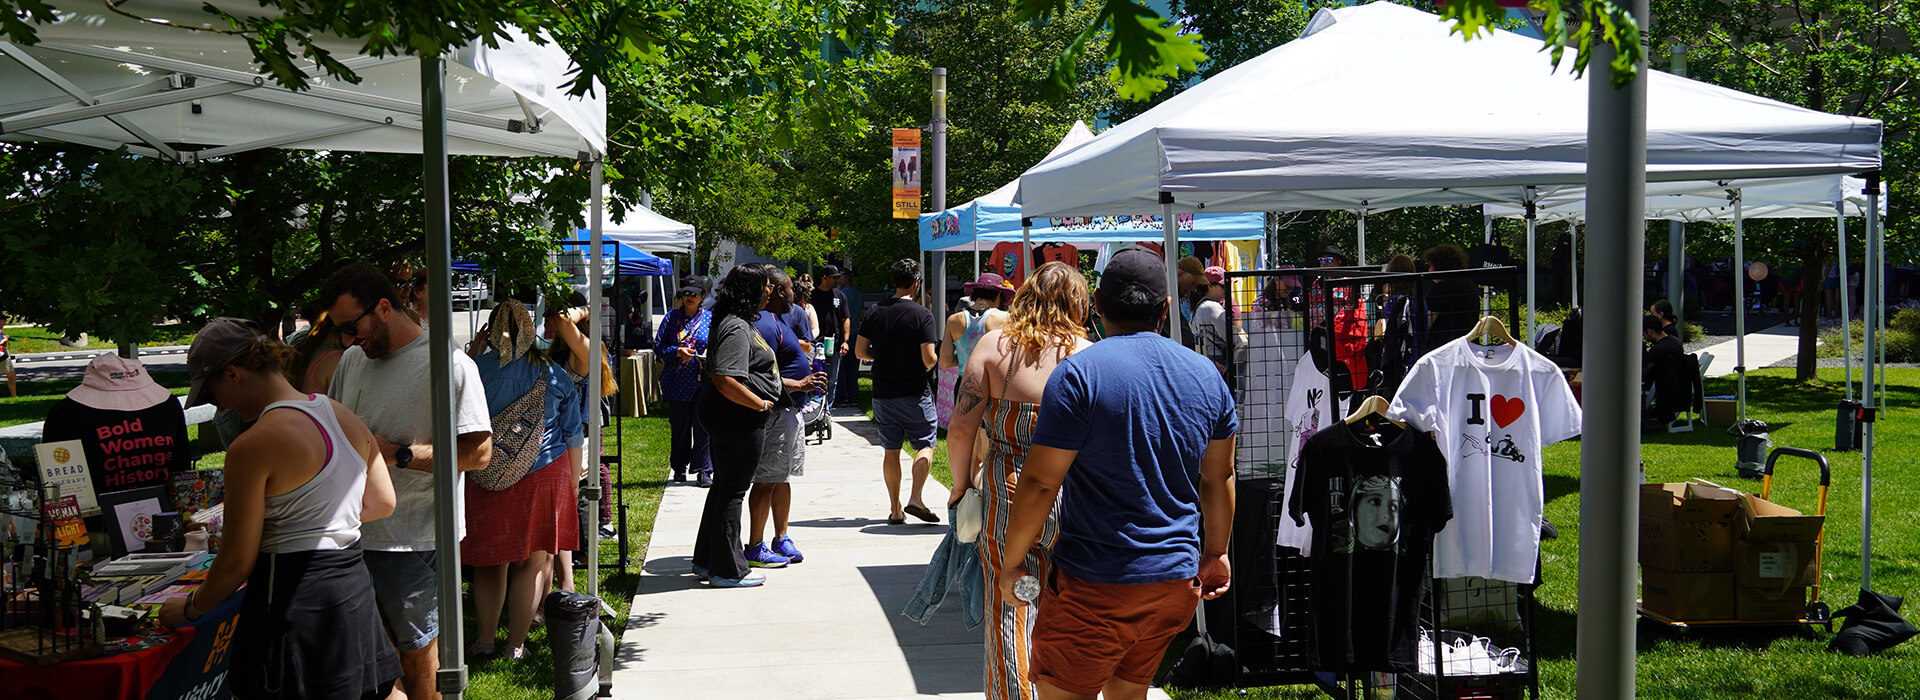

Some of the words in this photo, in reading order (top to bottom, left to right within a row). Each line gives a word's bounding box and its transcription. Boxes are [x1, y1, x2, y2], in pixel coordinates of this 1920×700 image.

[1466, 393, 1486, 425] I
[96, 418, 144, 440] Bold
[99, 435, 175, 455] Women
[46, 465, 84, 478] BREAD
[103, 450, 174, 472] Change
[104, 467, 169, 488] History
[57, 523, 81, 537] LIGHT
